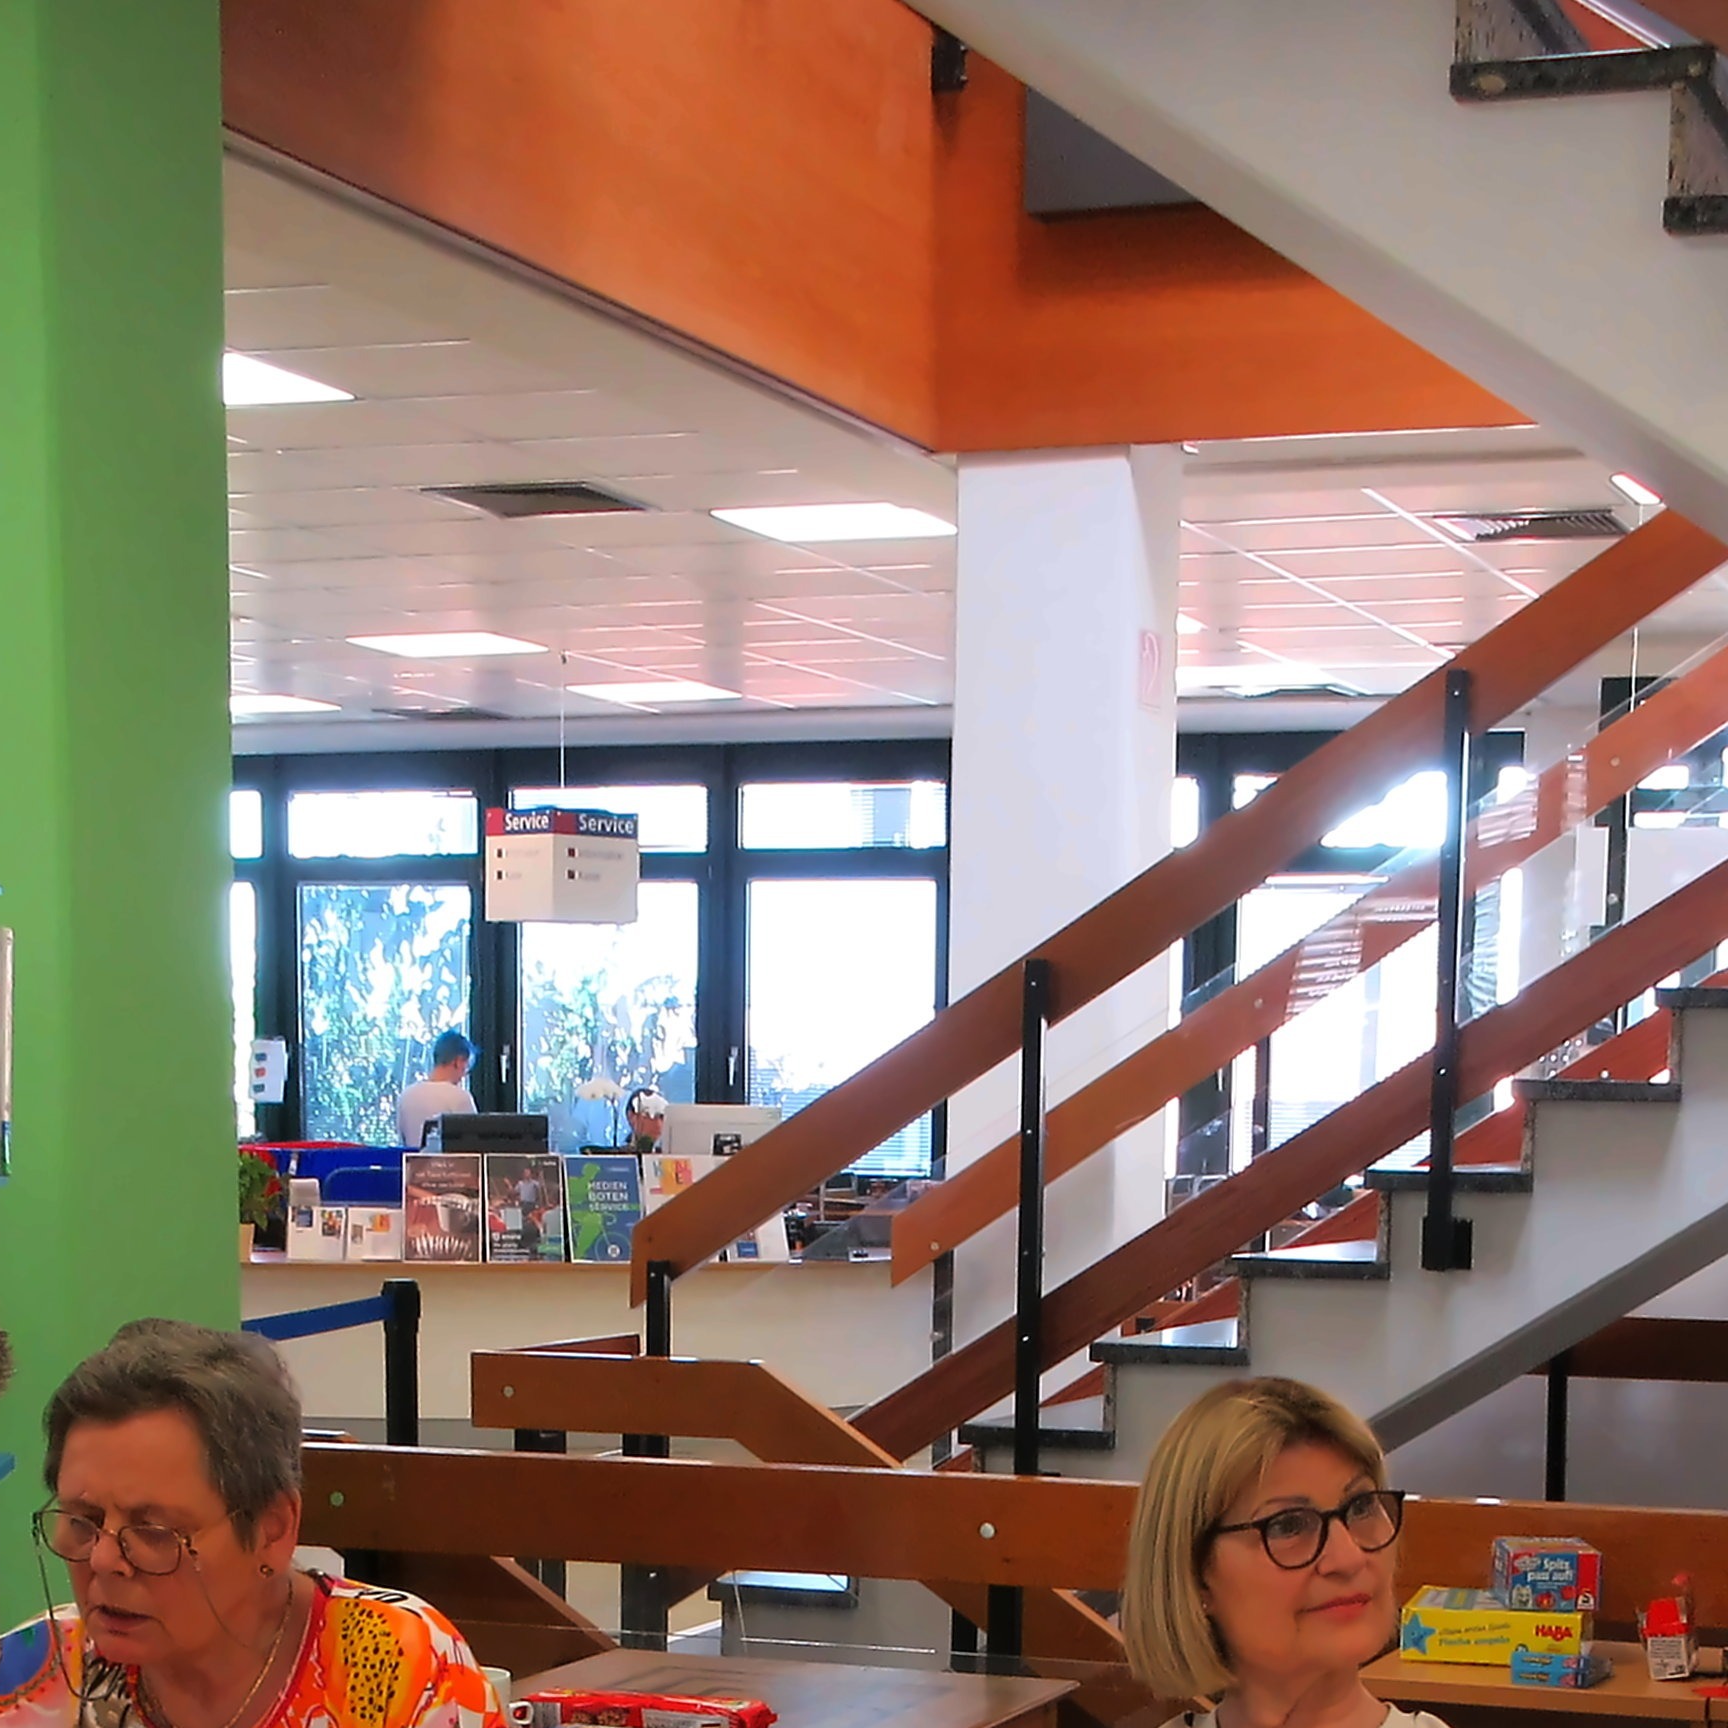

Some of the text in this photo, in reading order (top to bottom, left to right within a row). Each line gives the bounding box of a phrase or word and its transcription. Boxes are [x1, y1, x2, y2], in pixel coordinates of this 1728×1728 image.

[505, 813, 549, 830] Service
[579, 815, 634, 834] Service
[1535, 1625, 1572, 1641] HABA
